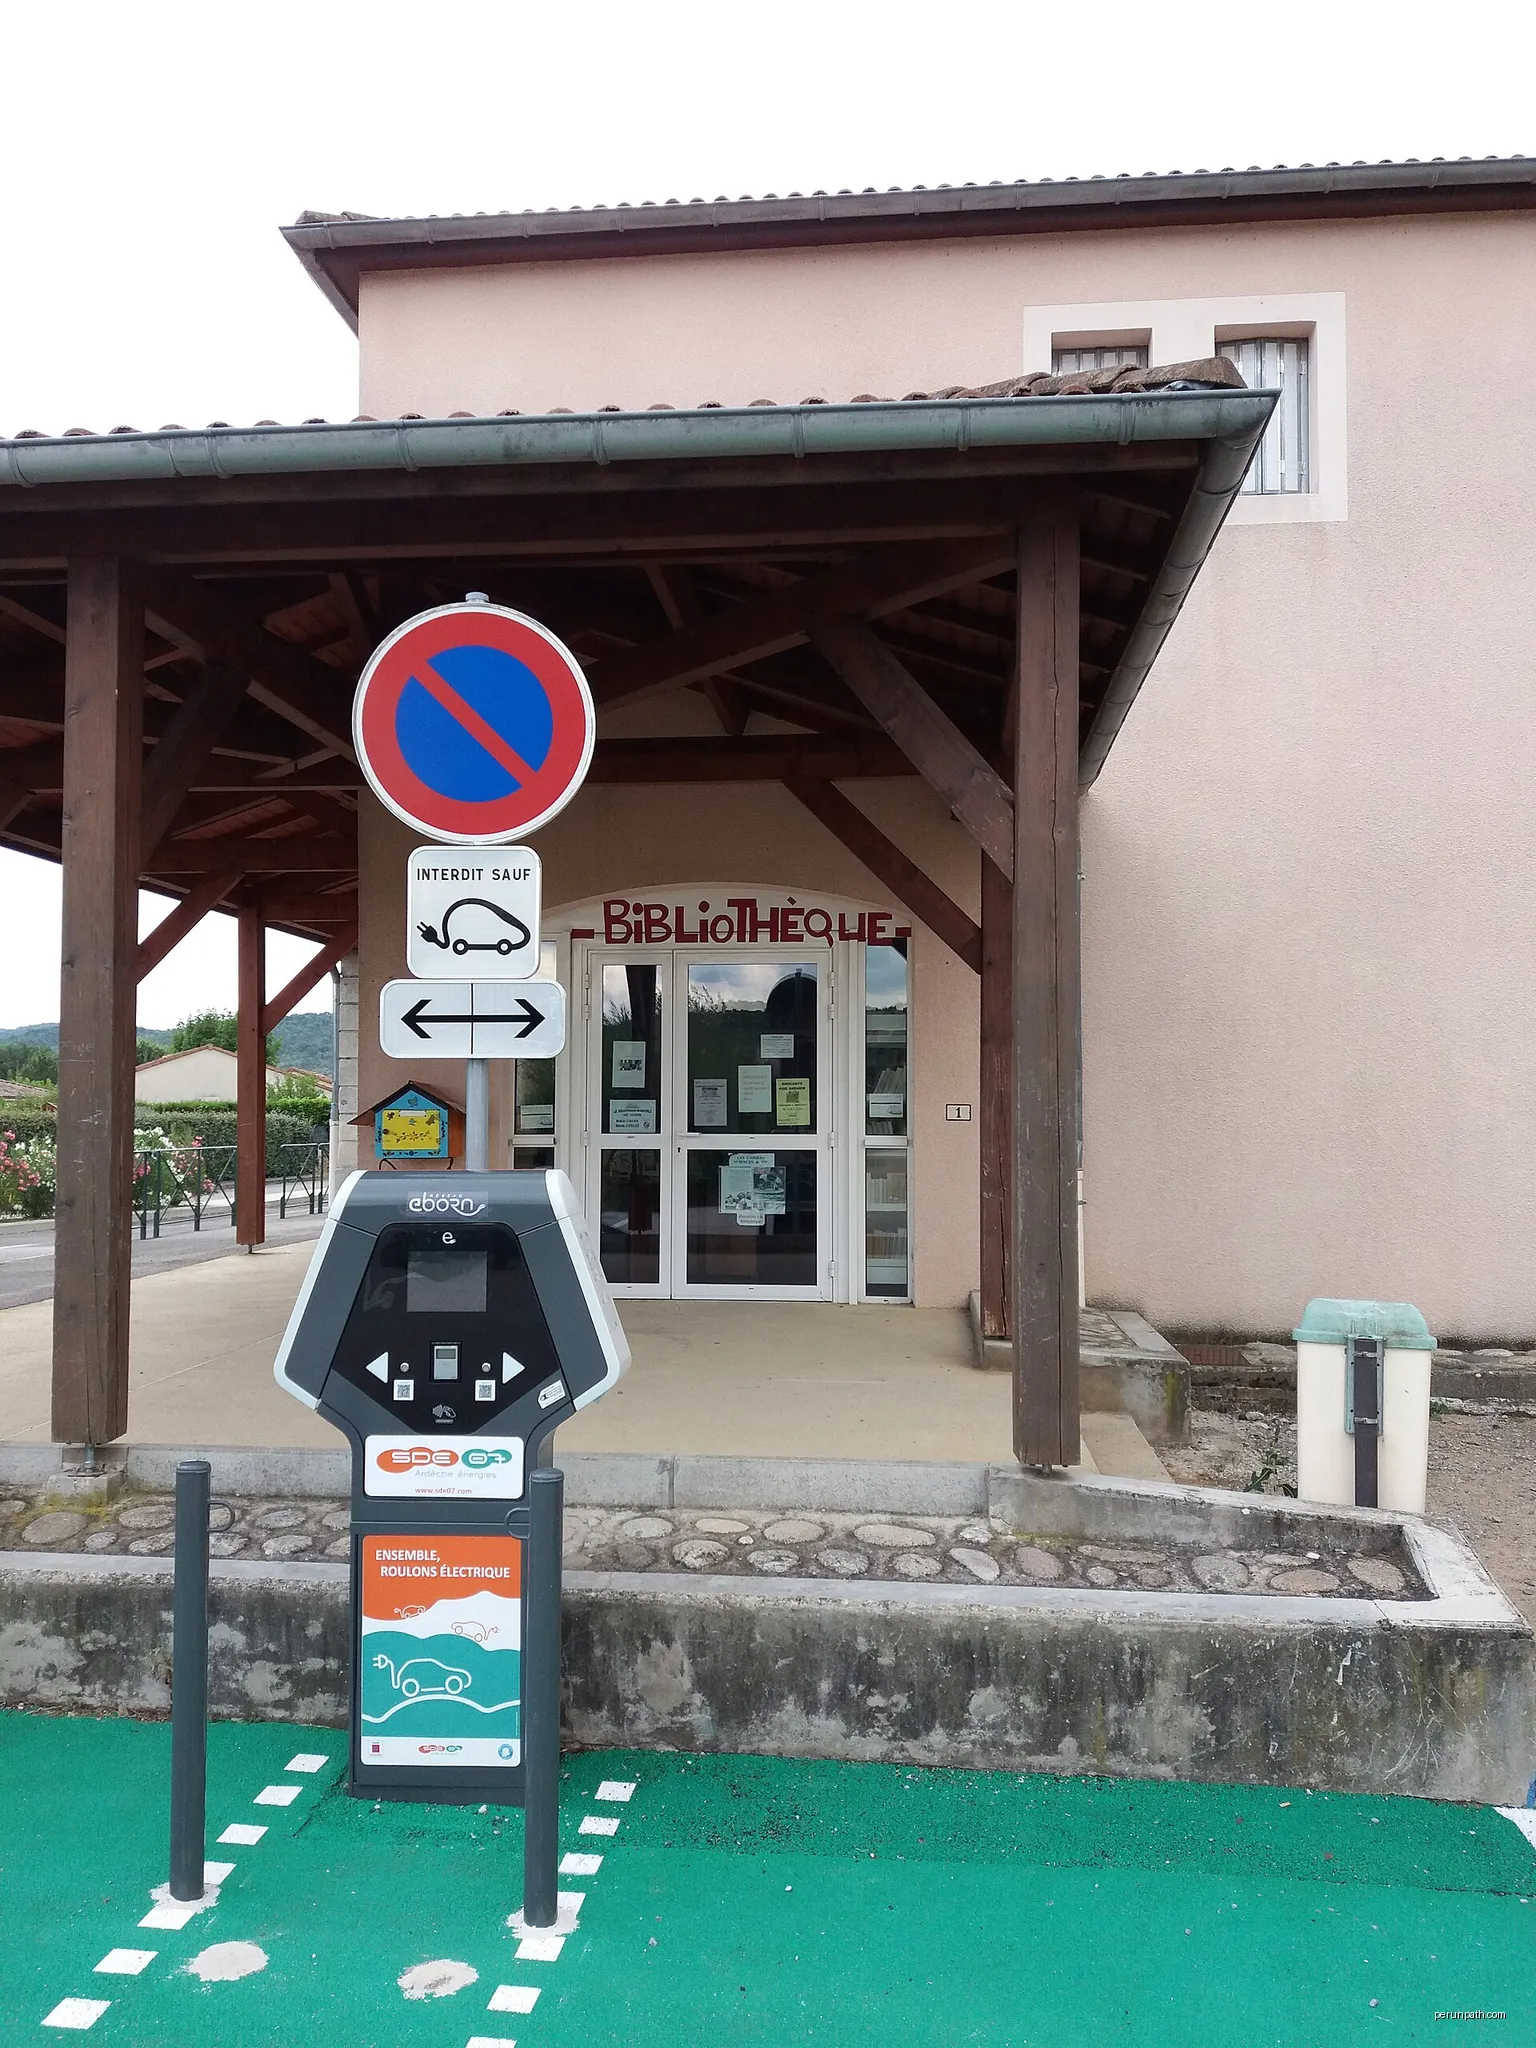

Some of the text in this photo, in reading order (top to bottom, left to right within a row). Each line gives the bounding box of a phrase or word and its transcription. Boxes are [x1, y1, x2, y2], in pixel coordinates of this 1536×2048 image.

[417, 868, 531, 881] INTERDIT SAUF
[955, 1107, 962, 1118] 1
[409, 1192, 486, 1217] eborn
[391, 1452, 506, 1465] SDE 07
[414, 1470, 497, 1480] Ardèche énergies
[414, 1487, 472, 1495] www.sde07.com
[375, 1549, 441, 1563] ENSEMBLE,
[380, 1564, 511, 1579] ROULONS ÉLECTRIQUE
